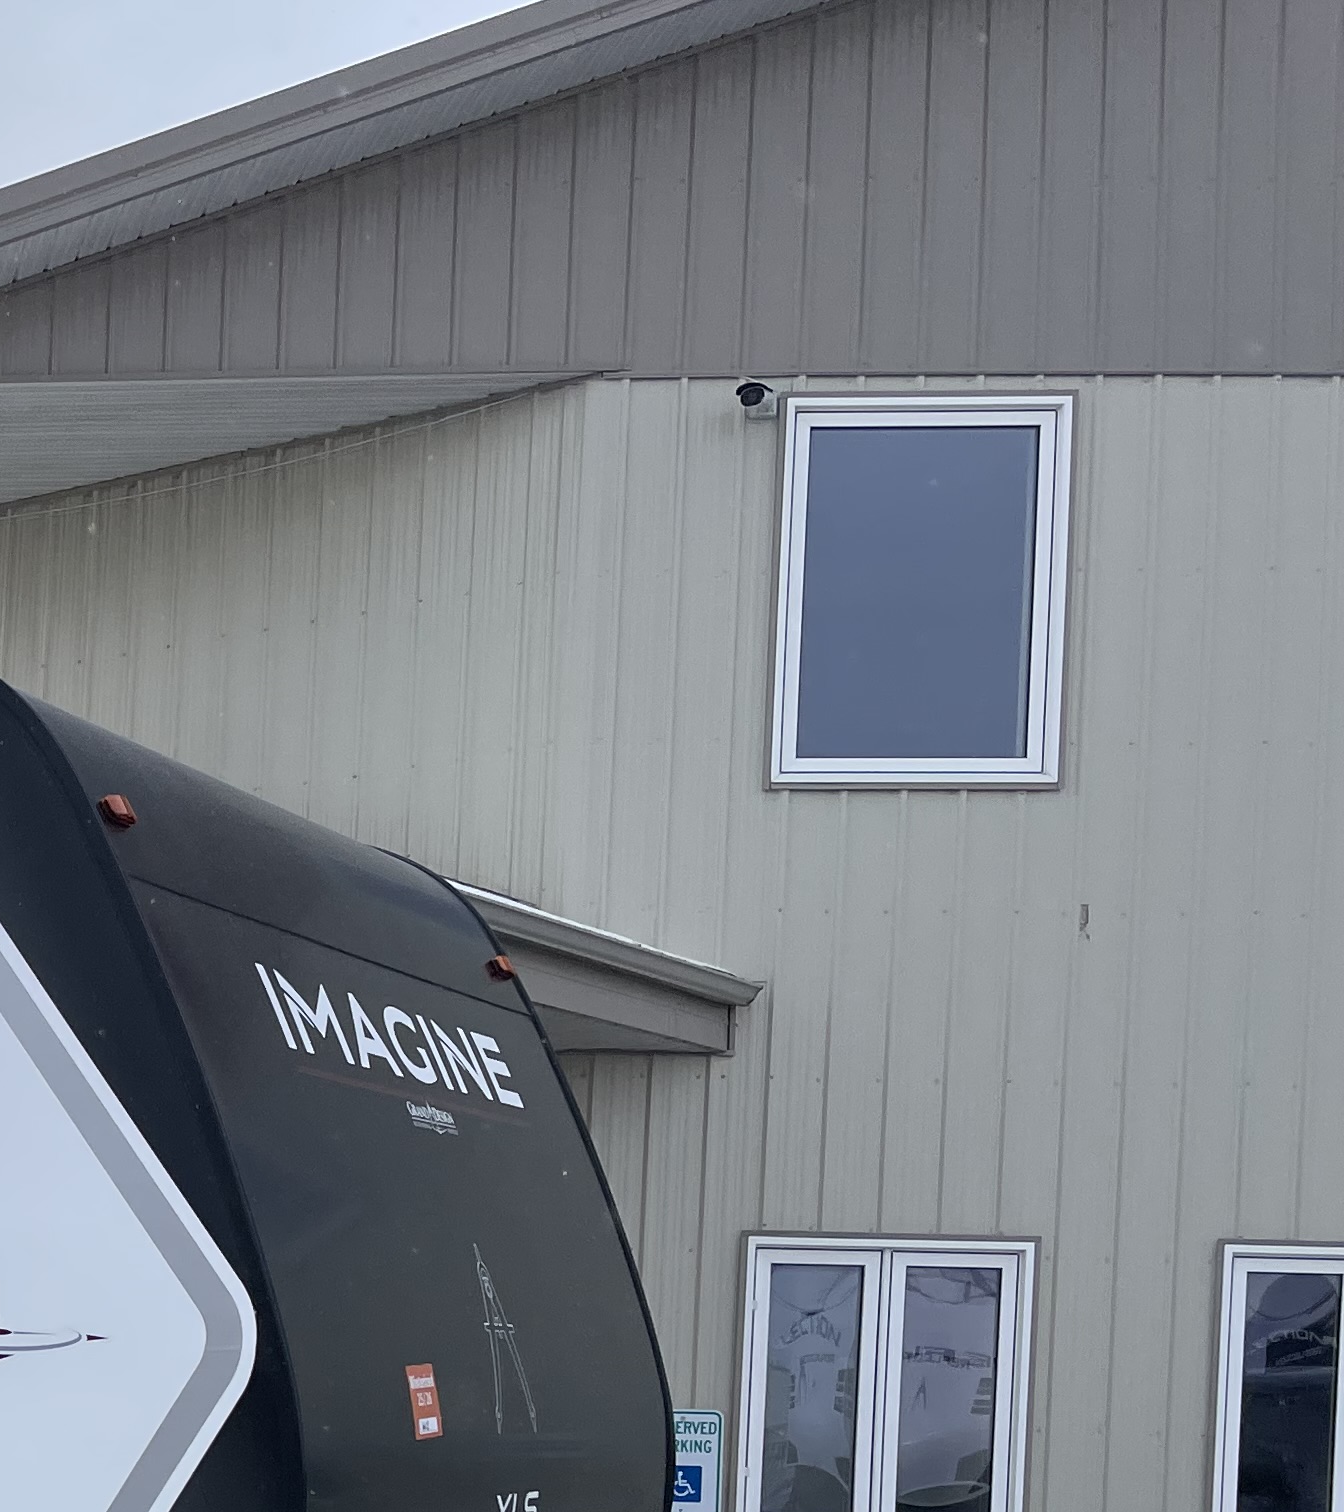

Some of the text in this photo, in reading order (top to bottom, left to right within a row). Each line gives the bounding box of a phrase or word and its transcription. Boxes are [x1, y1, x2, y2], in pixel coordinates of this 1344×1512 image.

[255, 962, 524, 1108] IMAGINE
[675, 1420, 717, 1435] ERVED
[674, 1439, 712, 1454] RKING
